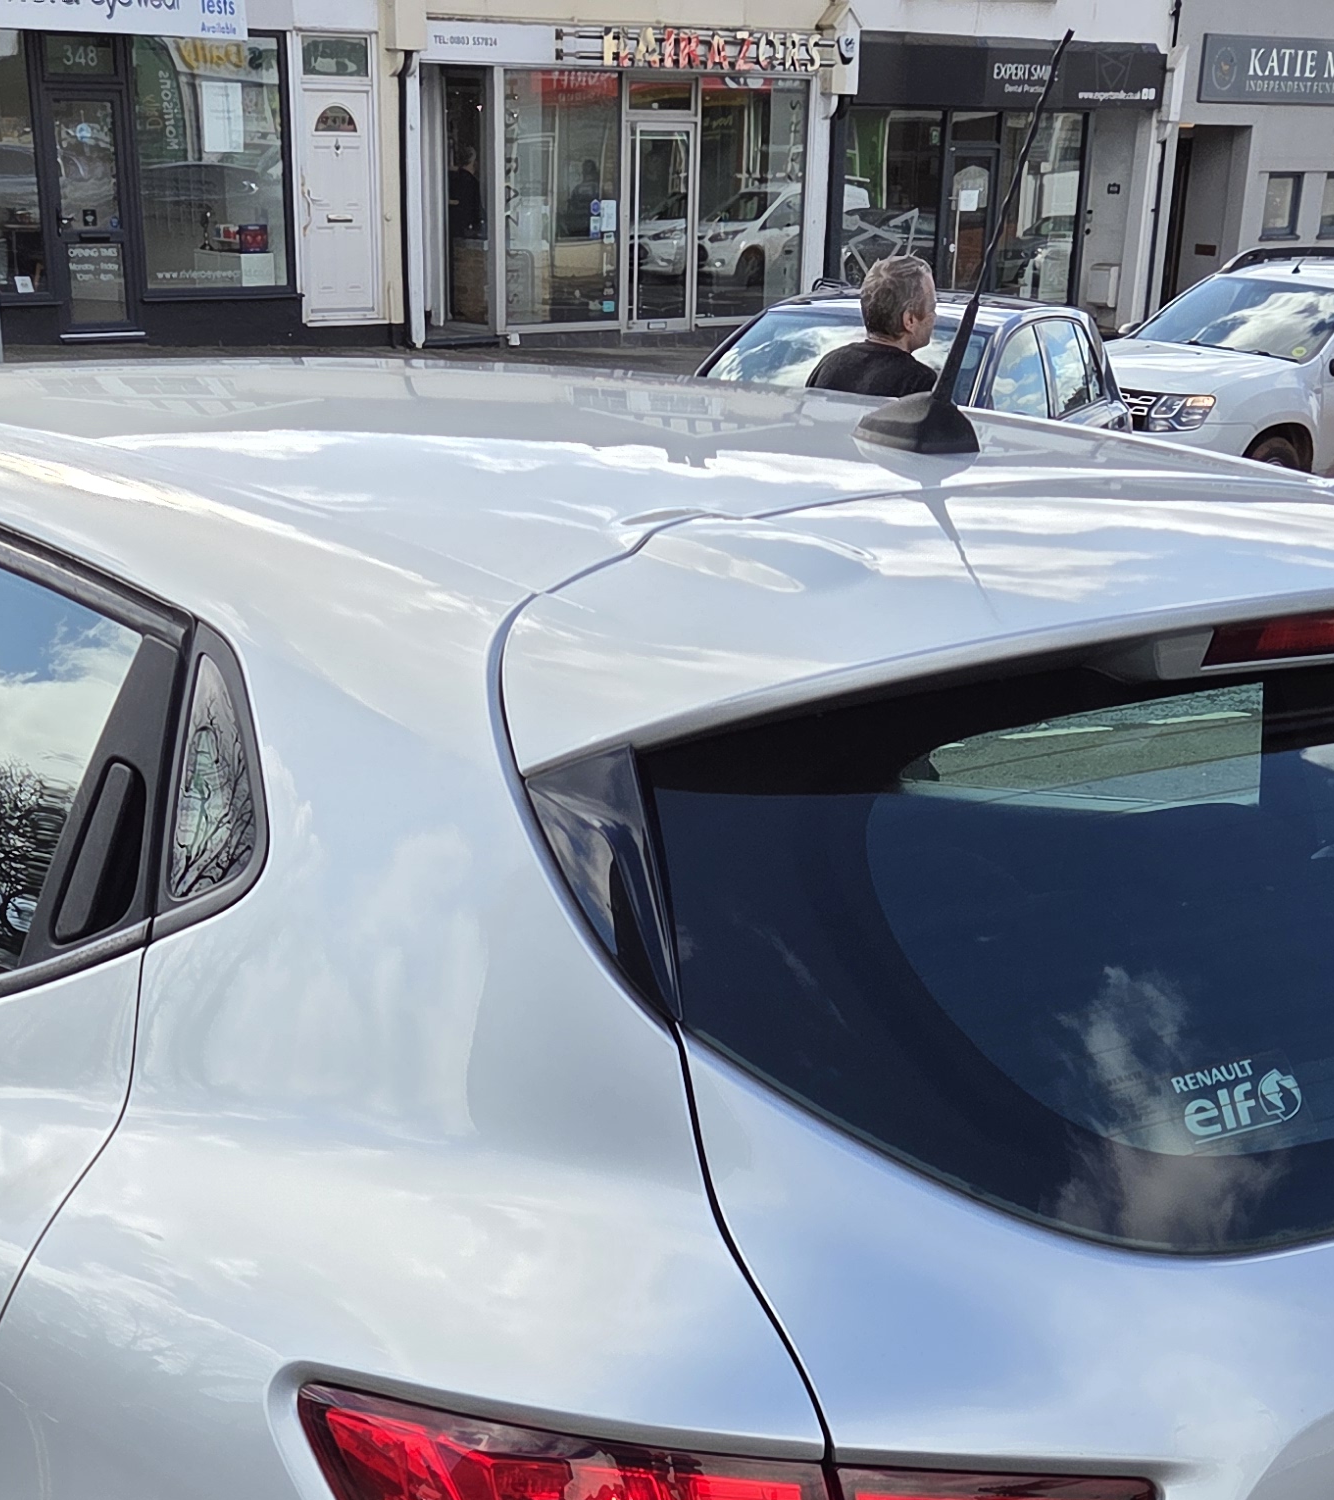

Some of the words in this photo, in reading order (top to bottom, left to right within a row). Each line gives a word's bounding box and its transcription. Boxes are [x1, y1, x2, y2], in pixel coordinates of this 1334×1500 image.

[63, 46, 97, 67] 348
[1248, 48, 1317, 77] KATIE
[993, 63, 1030, 80] EXPERT
[1245, 79, 1312, 94] INDEPENDENT
[1171, 1059, 1253, 1094] RENAULT
[1184, 1081, 1255, 1136] elf
